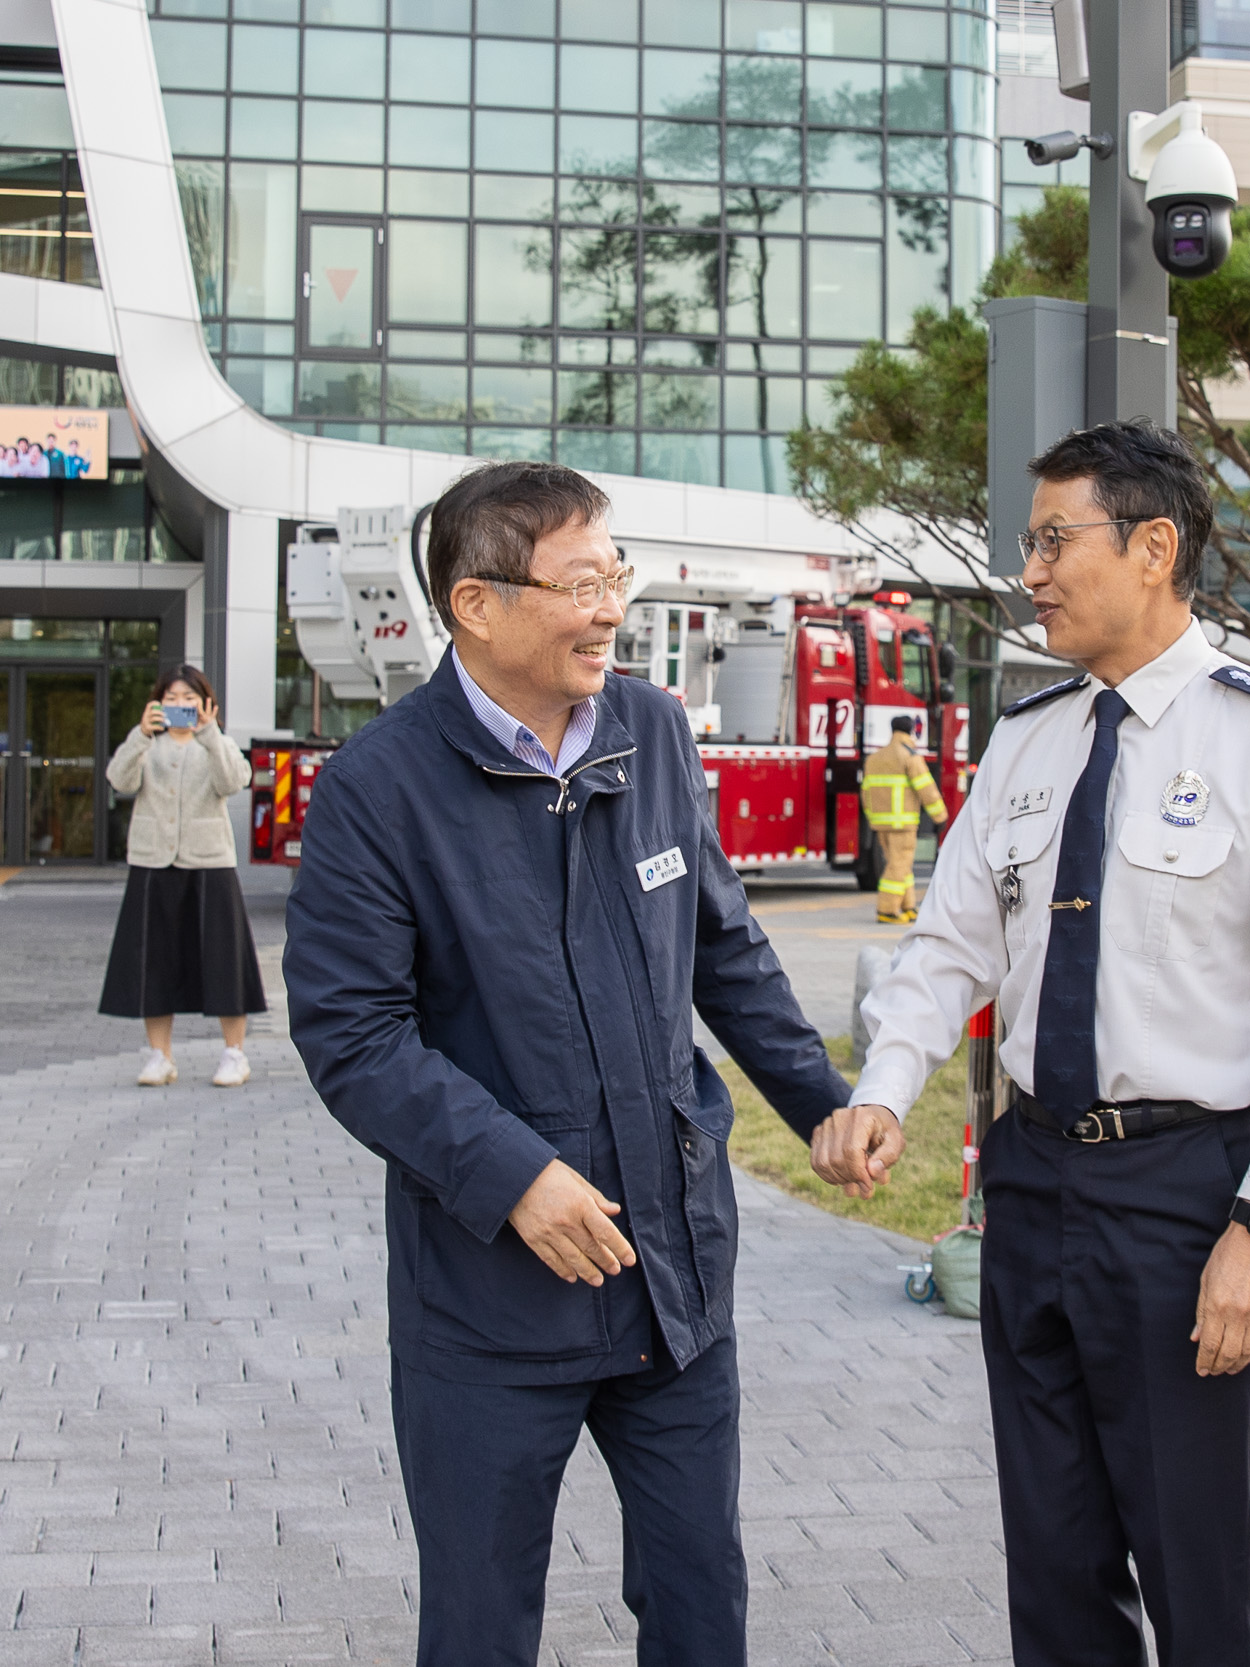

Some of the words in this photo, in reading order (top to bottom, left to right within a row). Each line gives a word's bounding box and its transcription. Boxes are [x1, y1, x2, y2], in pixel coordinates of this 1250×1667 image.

[374, 620, 408, 639] 119
[815, 704, 850, 736] 19
[1172, 793, 1198, 803] 119
